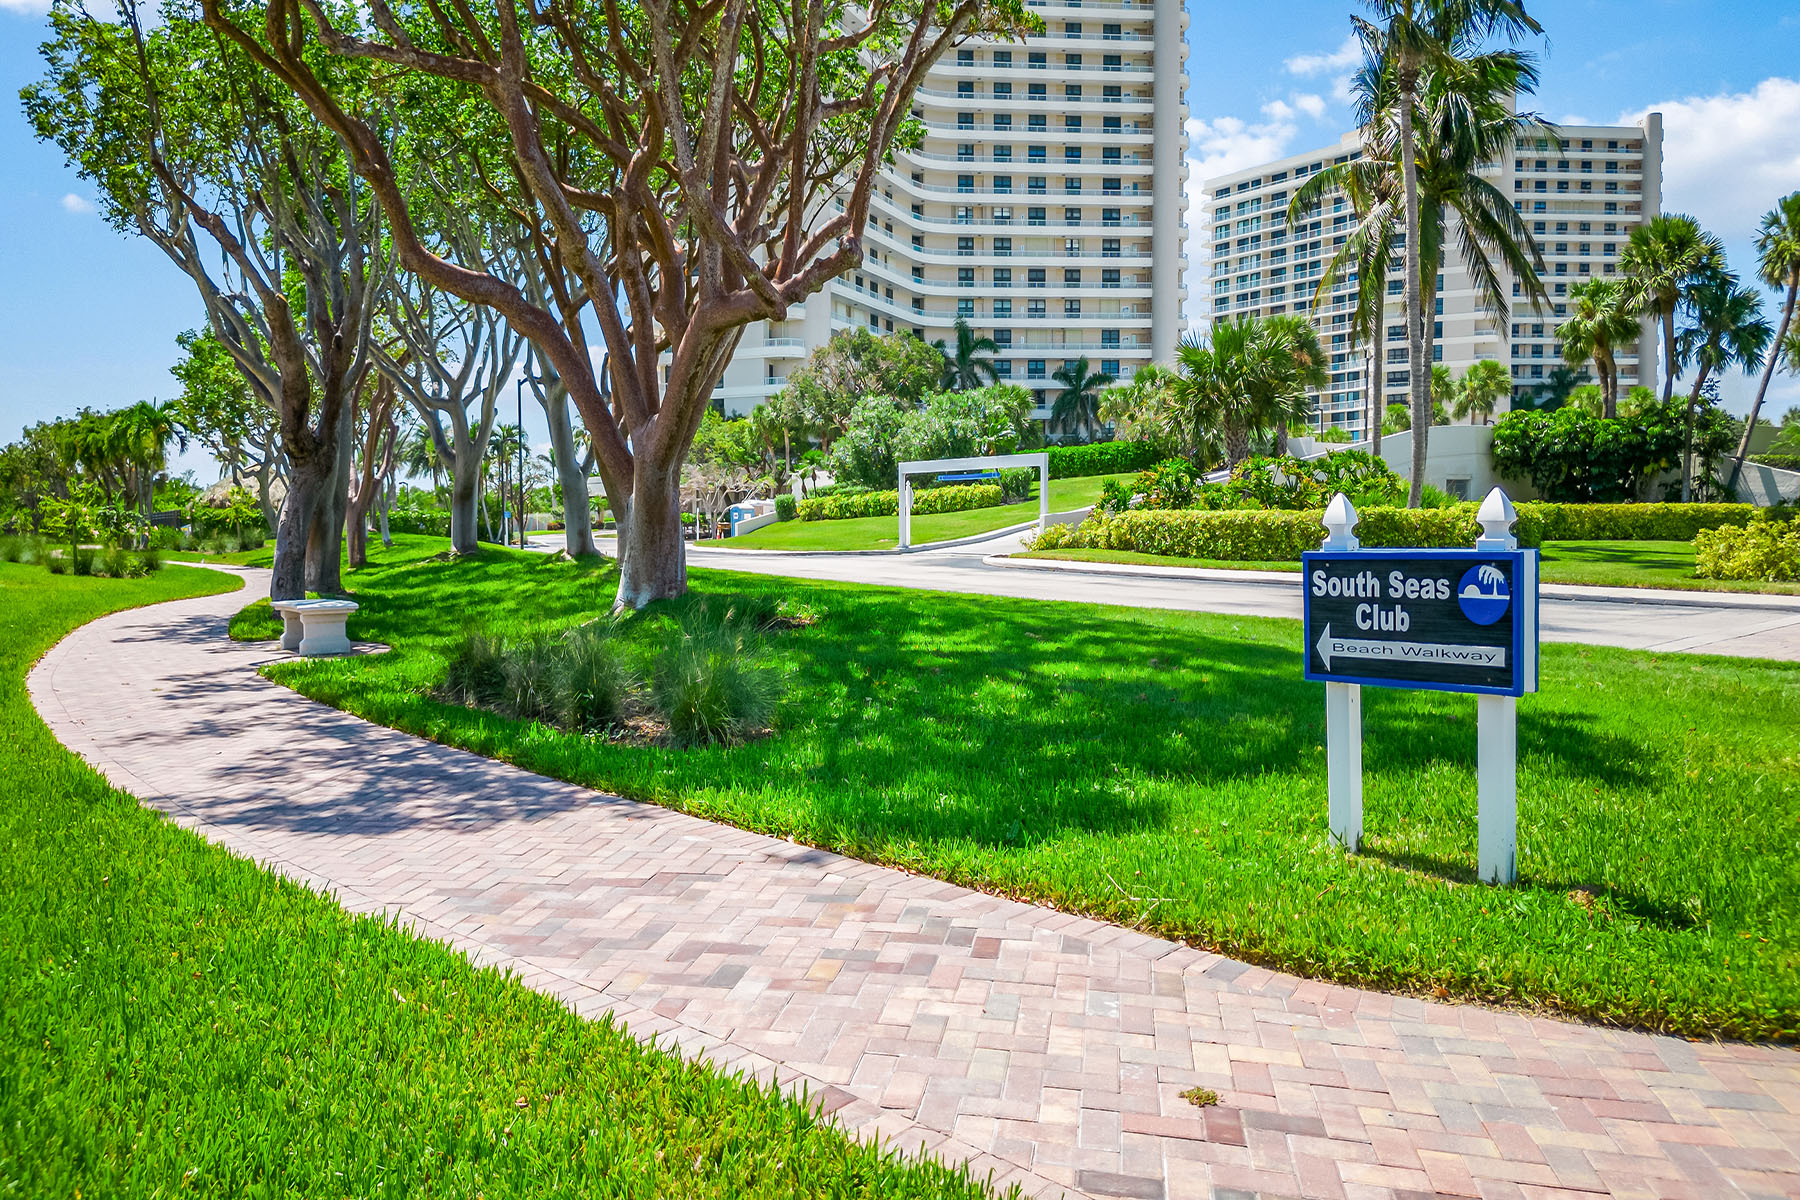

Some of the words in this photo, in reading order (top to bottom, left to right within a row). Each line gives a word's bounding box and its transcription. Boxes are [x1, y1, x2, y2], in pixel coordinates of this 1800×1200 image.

[1312, 570, 1380, 598] South
[1388, 570, 1450, 600] Seas
[1355, 603, 1410, 633] Club
[1332, 642, 1393, 656] Beach
[1400, 646, 1497, 663] Walkway
